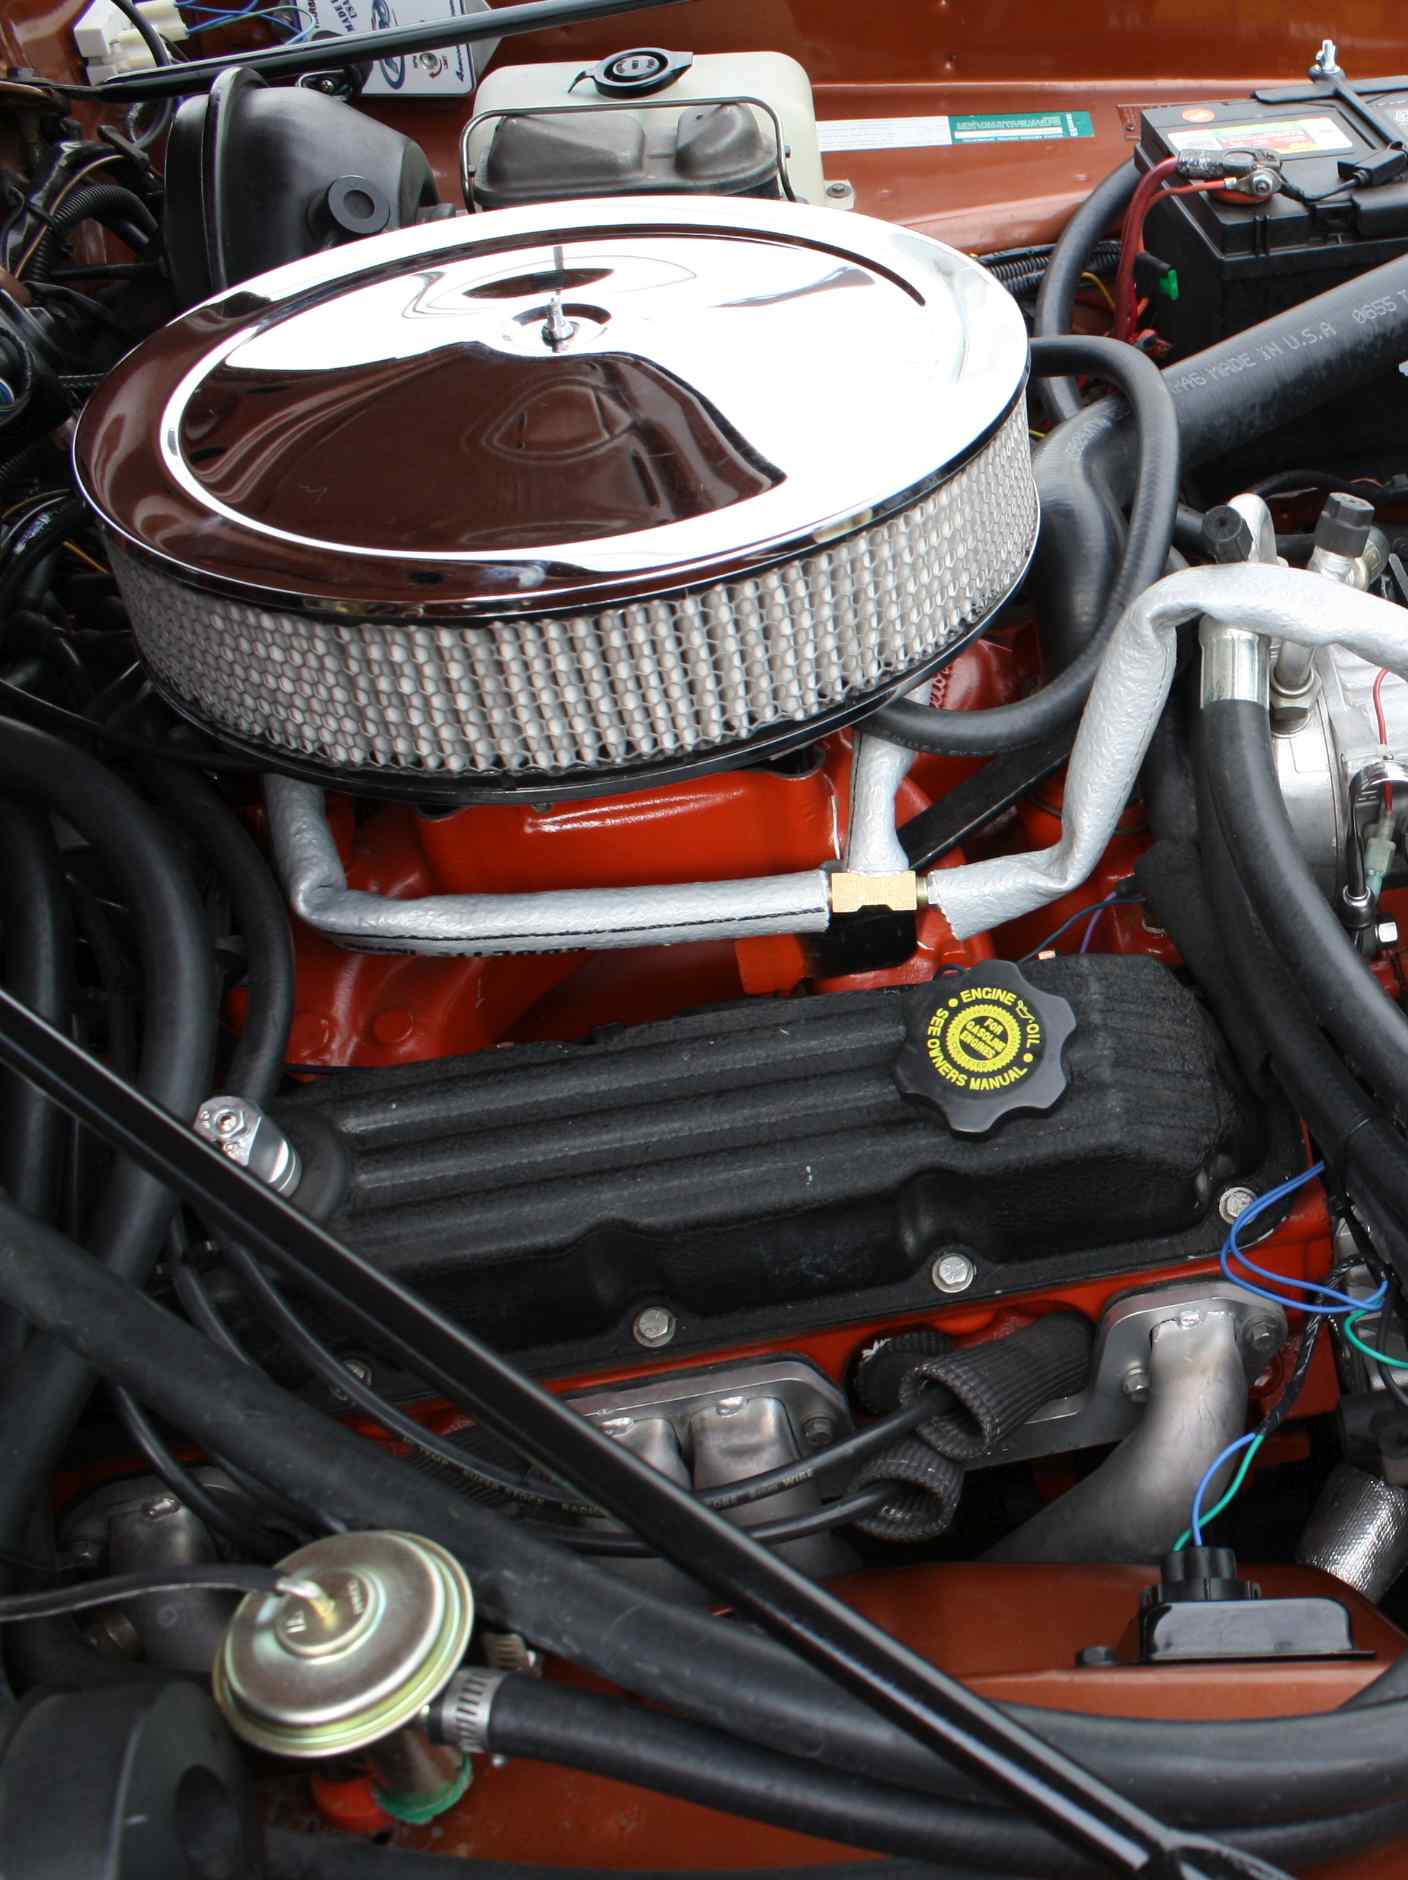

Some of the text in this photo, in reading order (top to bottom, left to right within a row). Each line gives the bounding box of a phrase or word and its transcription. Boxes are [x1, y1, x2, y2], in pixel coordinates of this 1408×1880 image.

[1208, 356, 1257, 381] MADE
[1257, 344, 1284, 361] IN
[960, 987, 1041, 1048] ENGINE OIL
[984, 1017, 1004, 1035] FOR
[927, 1007, 1028, 1091] SEE OWNERS MANUAL
